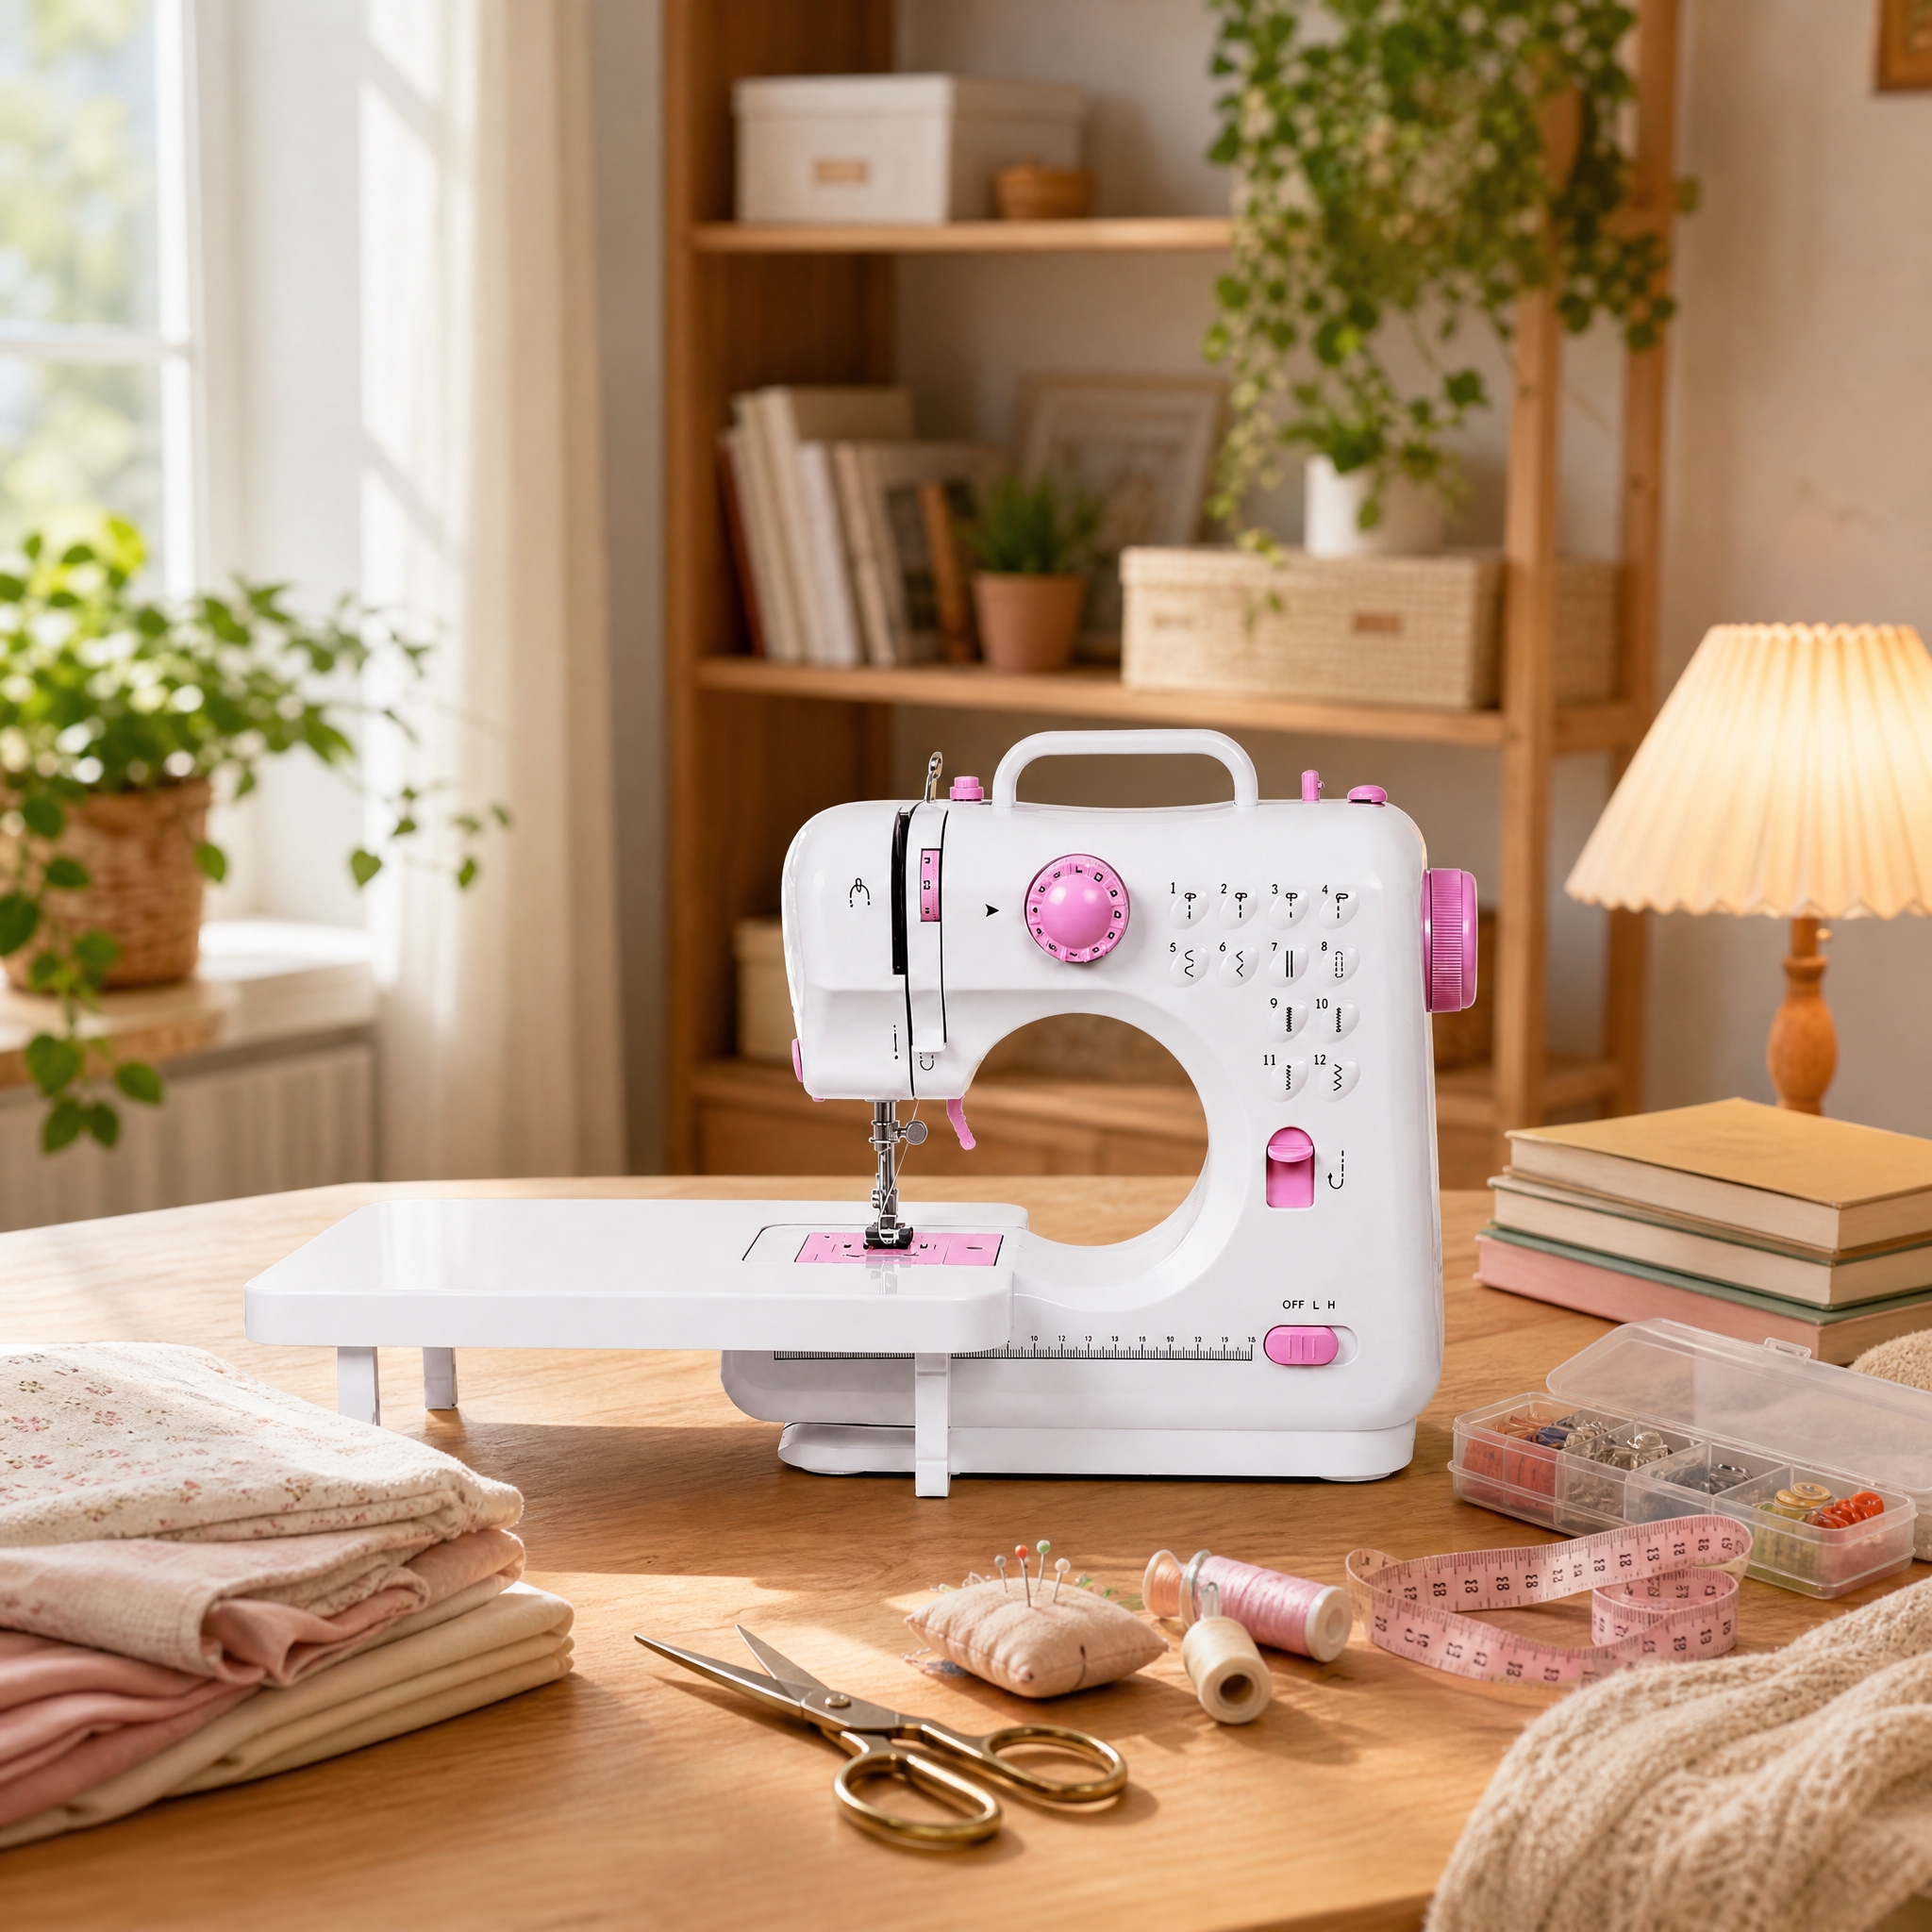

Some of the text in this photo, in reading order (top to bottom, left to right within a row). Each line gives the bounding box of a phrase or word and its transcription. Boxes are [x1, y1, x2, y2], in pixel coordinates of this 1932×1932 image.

[1171, 882, 1176, 894] 1
[1221, 883, 1227, 894] 2
[1271, 883, 1278, 894] 3
[1322, 884, 1328, 895] 4
[1169, 941, 1176, 953] 5
[1219, 941, 1226, 953] 6
[1272, 941, 1278, 952] 7
[1321, 941, 1328, 952] 8
[1270, 997, 1278, 1009] 9
[1315, 998, 1328, 1009] 10
[1263, 1054, 1276, 1066] 11
[1314, 1054, 1326, 1066] 12
[1282, 1299, 1336, 1310] OFF L H
